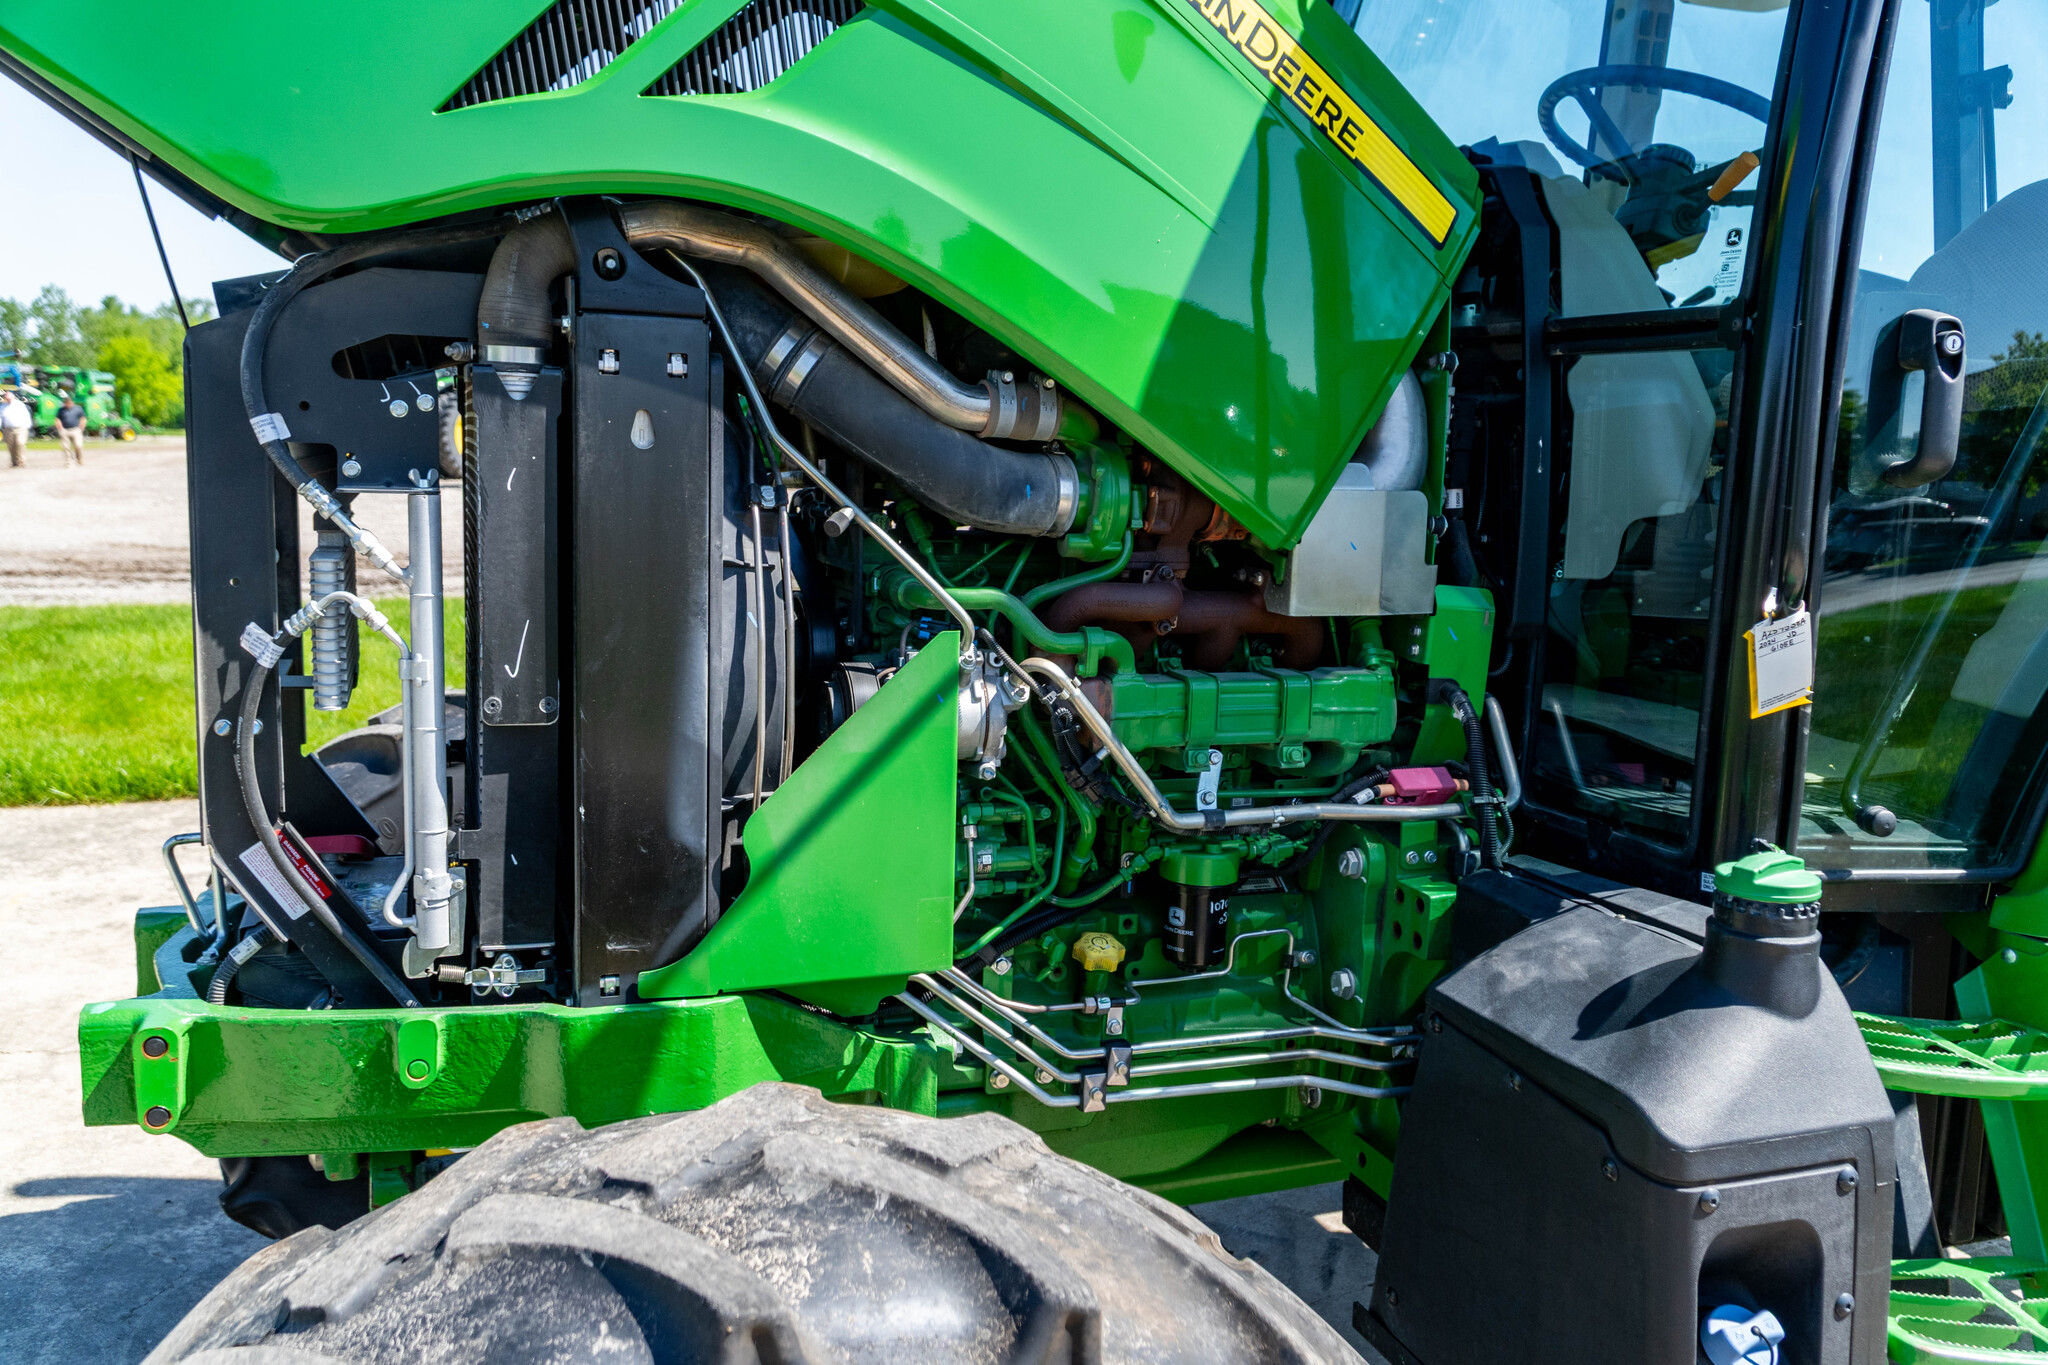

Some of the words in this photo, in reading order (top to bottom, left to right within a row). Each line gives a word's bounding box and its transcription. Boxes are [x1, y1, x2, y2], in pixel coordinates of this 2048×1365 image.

[1245, 18, 1364, 153] DEERE
[1787, 630, 1797, 638] JD
[283, 840, 301, 860] DANGER!
[304, 864, 320, 882] POISON!
[1174, 928, 1194, 936] DEERE
